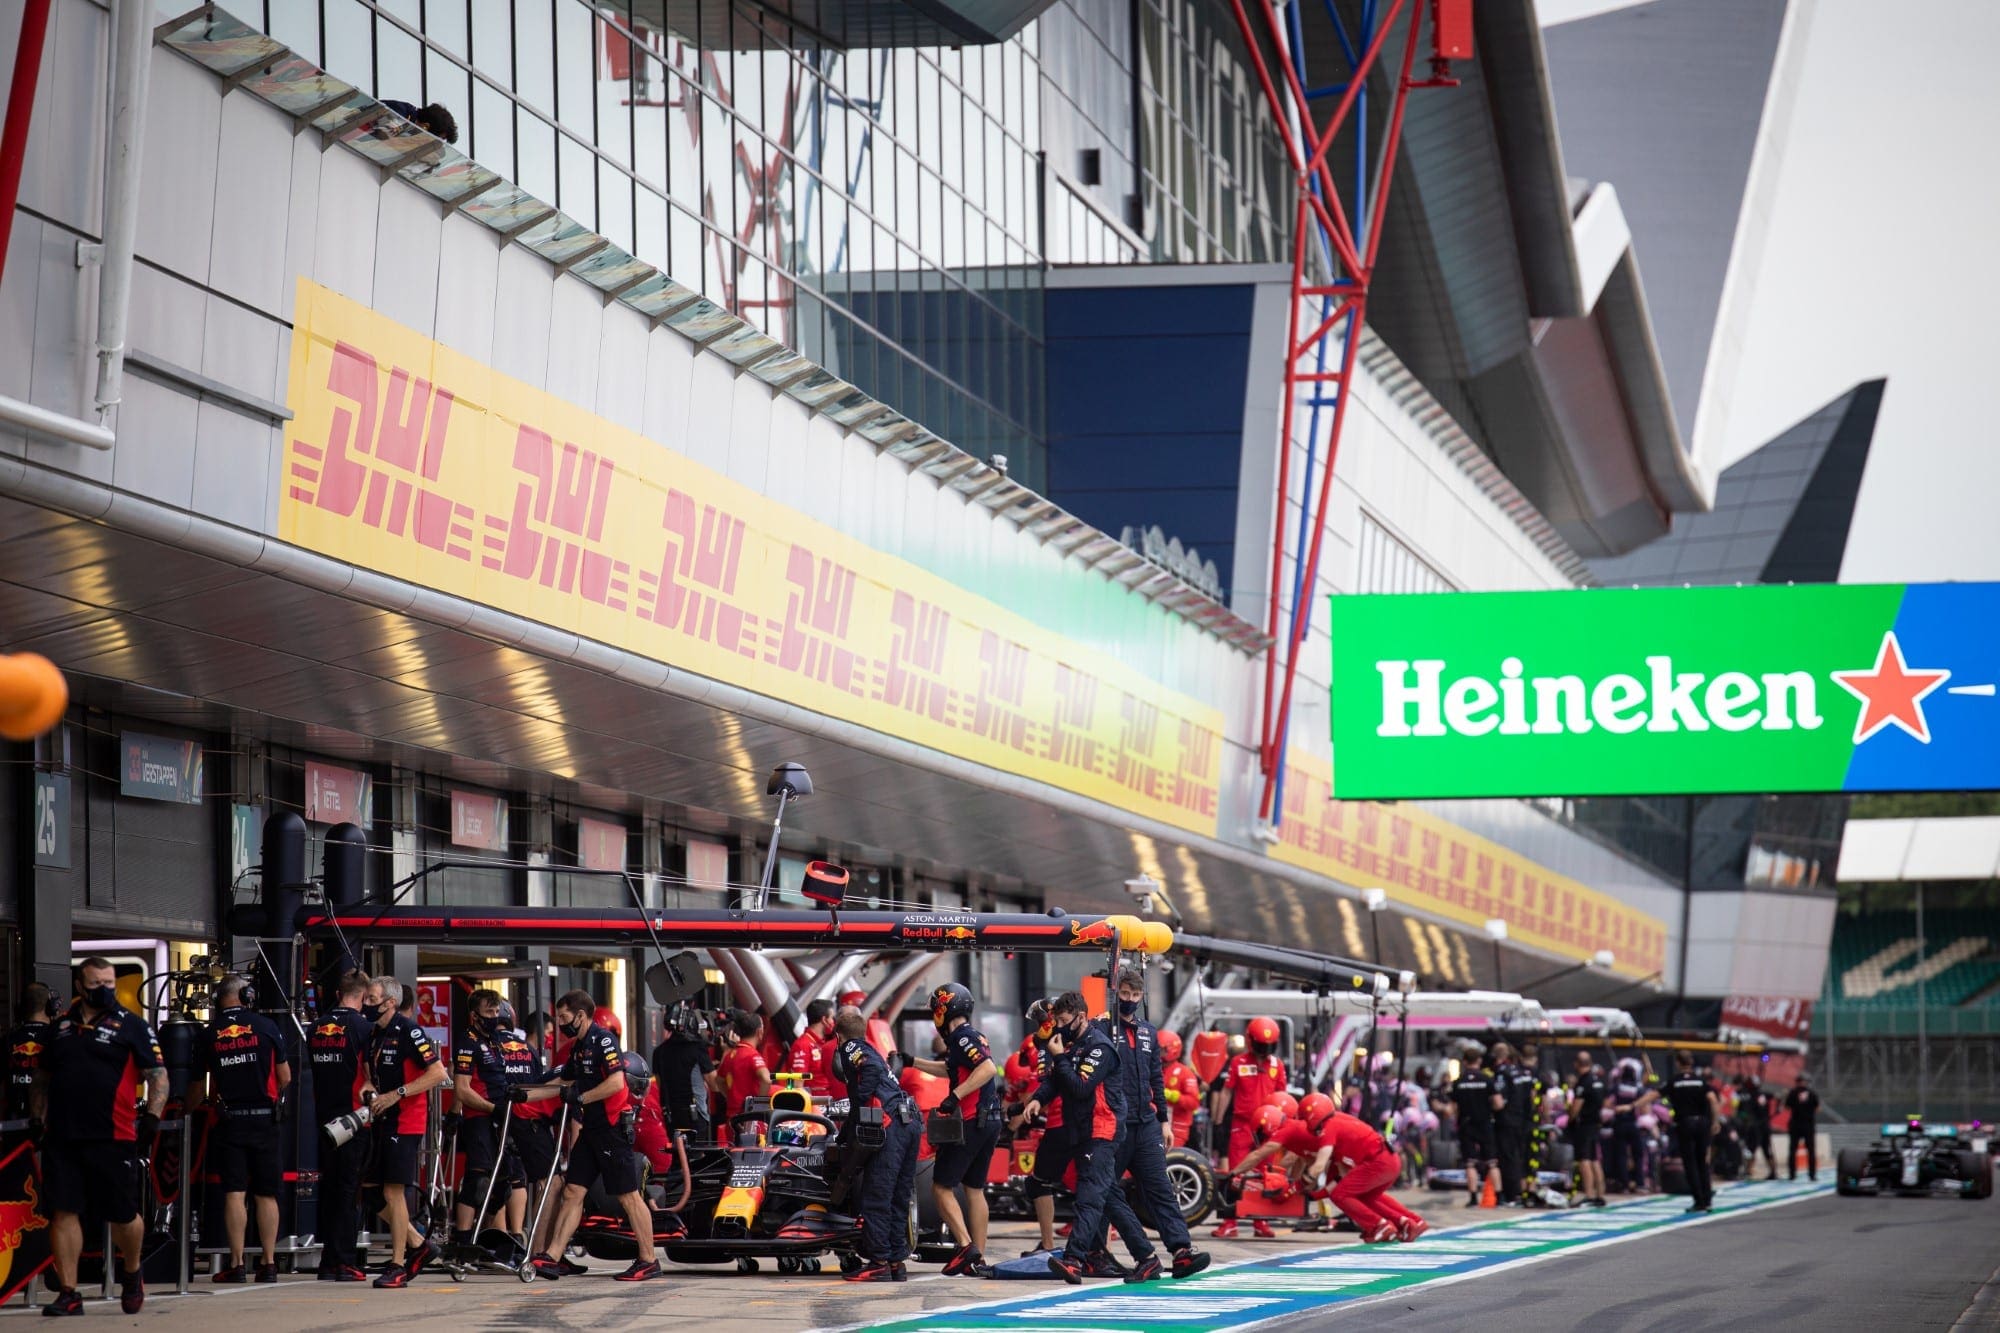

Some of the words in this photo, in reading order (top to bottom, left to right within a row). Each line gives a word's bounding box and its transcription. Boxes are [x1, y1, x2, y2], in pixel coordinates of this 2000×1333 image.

[289, 340, 474, 562] DHL
[481, 423, 630, 611] DHL
[636, 487, 758, 659] DHL
[764, 544, 866, 696] DHL
[871, 589, 958, 728] DHL
[963, 628, 1041, 756] DHL
[1376, 655, 1823, 736] Heineken
[142, 763, 177, 787] VERSTAPPEN
[37, 785, 56, 855] 25
[233, 814, 249, 878] 24
[903, 927, 923, 937] Red
[923, 927, 943, 938] Bull
[939, 916, 977, 924] MARTIN
[214, 1038, 237, 1052] Red
[237, 1035, 258, 1048] Bull
[220, 1053, 247, 1067] Mobil
[313, 1052, 333, 1063] Mobil
[504, 1051, 516, 1061] ed
[516, 1051, 532, 1061] Bull
